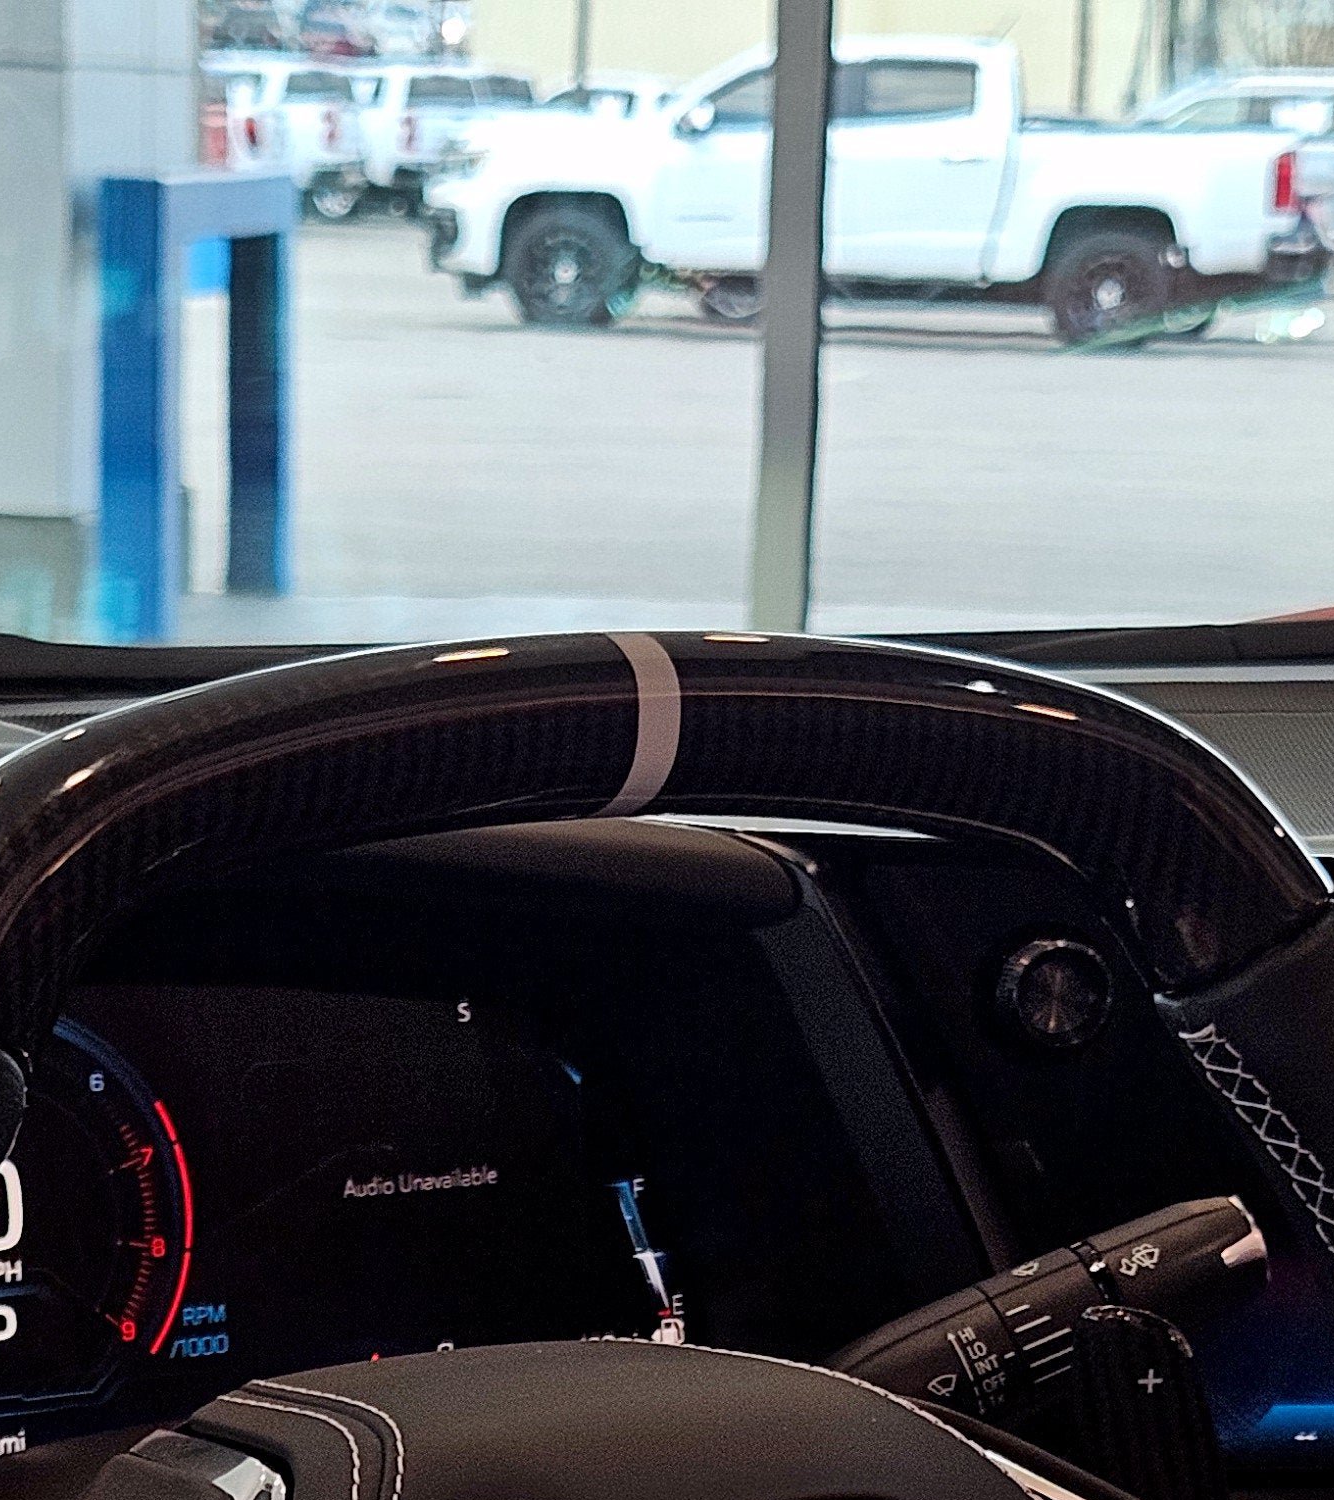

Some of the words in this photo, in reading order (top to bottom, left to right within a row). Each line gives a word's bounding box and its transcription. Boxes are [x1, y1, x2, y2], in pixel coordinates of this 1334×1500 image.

[457, 1001, 472, 1023] S
[88, 1072, 105, 1093] 6
[140, 1146, 154, 1167] 7
[343, 1175, 394, 1199] Audio
[398, 1165, 498, 1193] Unavailable
[631, 1177, 645, 1199] F
[150, 1237, 166, 1258] 8
[182, 1303, 227, 1325] RPM
[671, 1294, 685, 1316] E
[120, 1320, 135, 1341] 9
[957, 1326, 977, 1344] HI
[169, 1332, 230, 1359] /1000
[966, 1341, 987, 1360] LO
[974, 1354, 999, 1375] INT
[982, 1371, 1007, 1392] OFF
